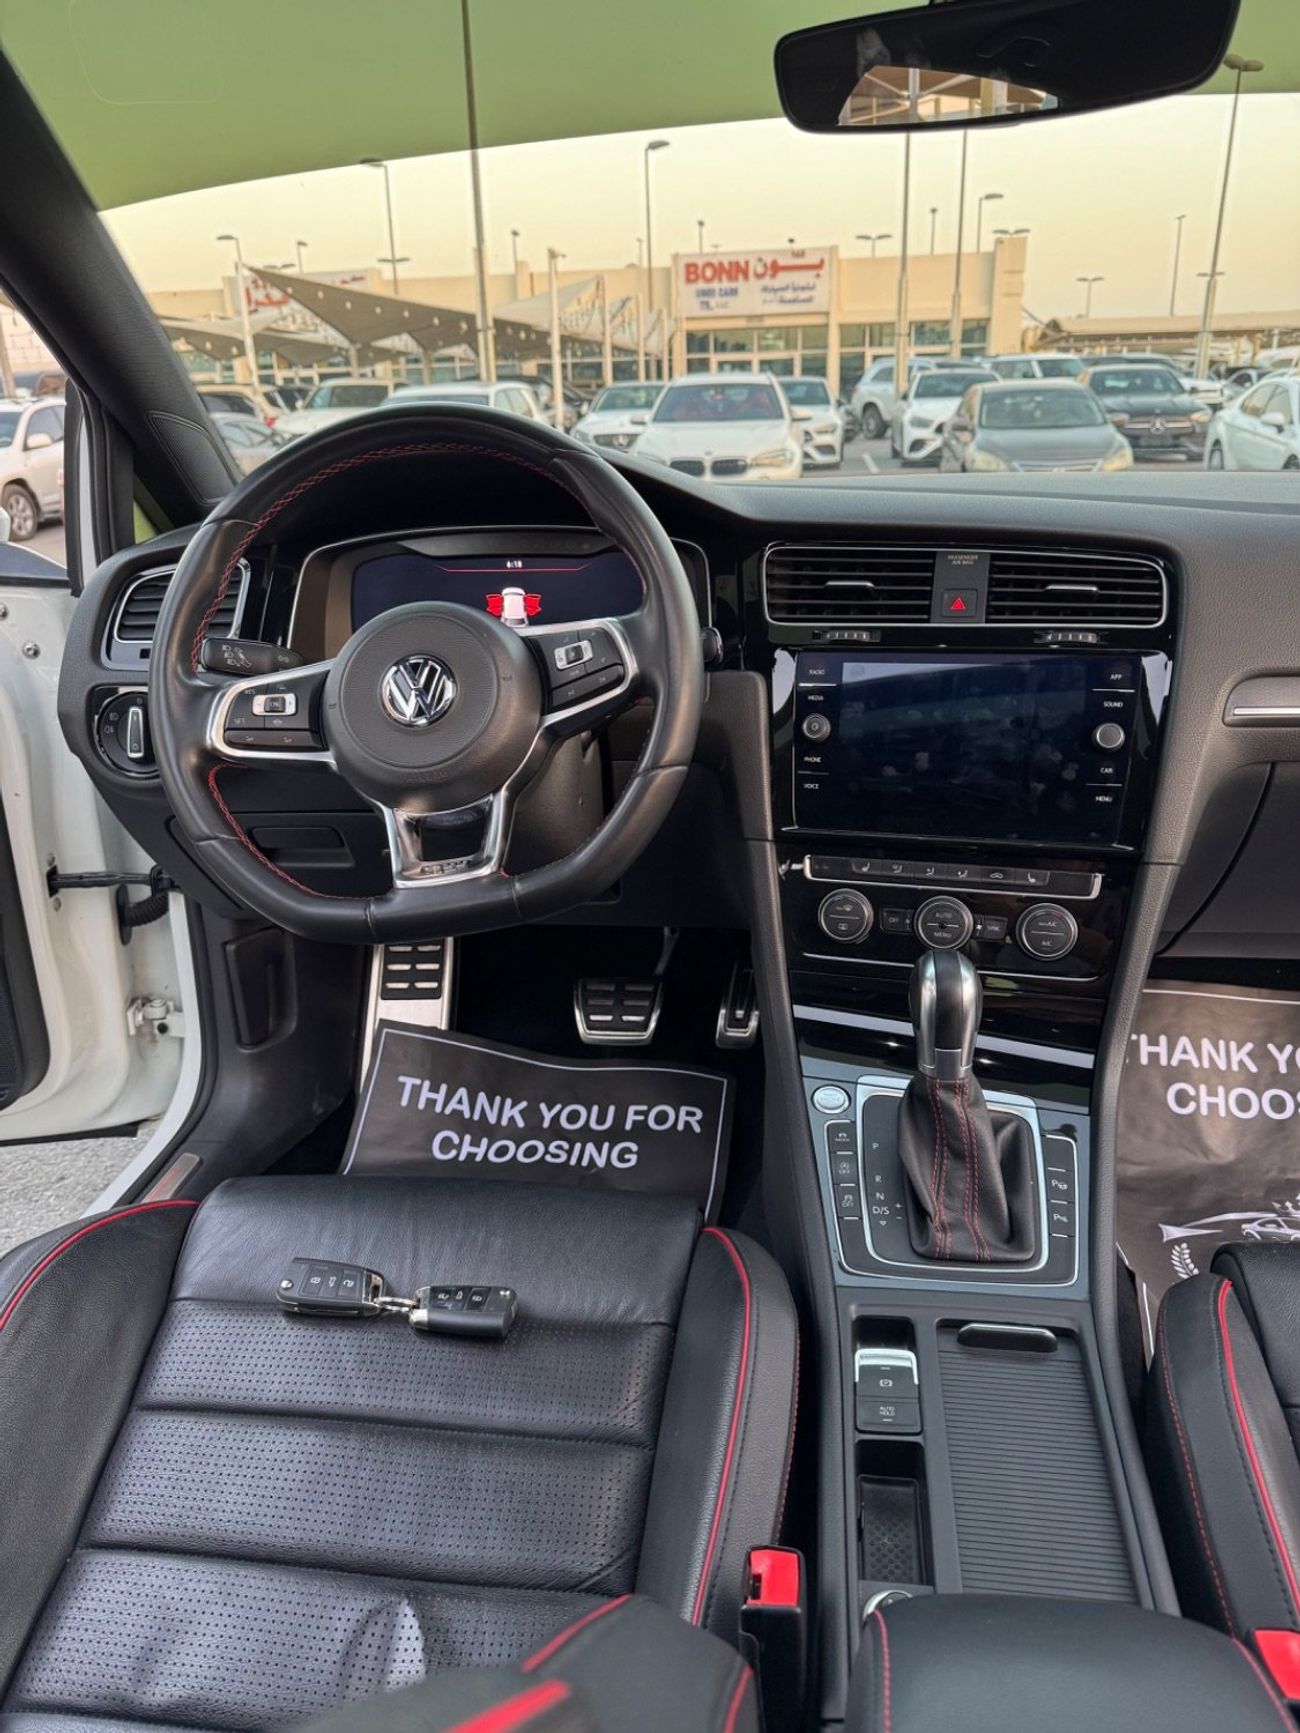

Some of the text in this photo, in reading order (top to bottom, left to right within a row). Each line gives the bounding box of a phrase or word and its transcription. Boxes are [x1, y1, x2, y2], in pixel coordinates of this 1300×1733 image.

[684, 260, 750, 284] BONN
[1129, 1033, 1258, 1073] HANK
[398, 1075, 703, 1133] THANK YOU FOR
[1166, 1082, 1300, 1120] CHOO
[432, 1130, 639, 1169] CHOOSING
[872, 1206, 890, 1215] D/S
[876, 1192, 885, 1201] N
